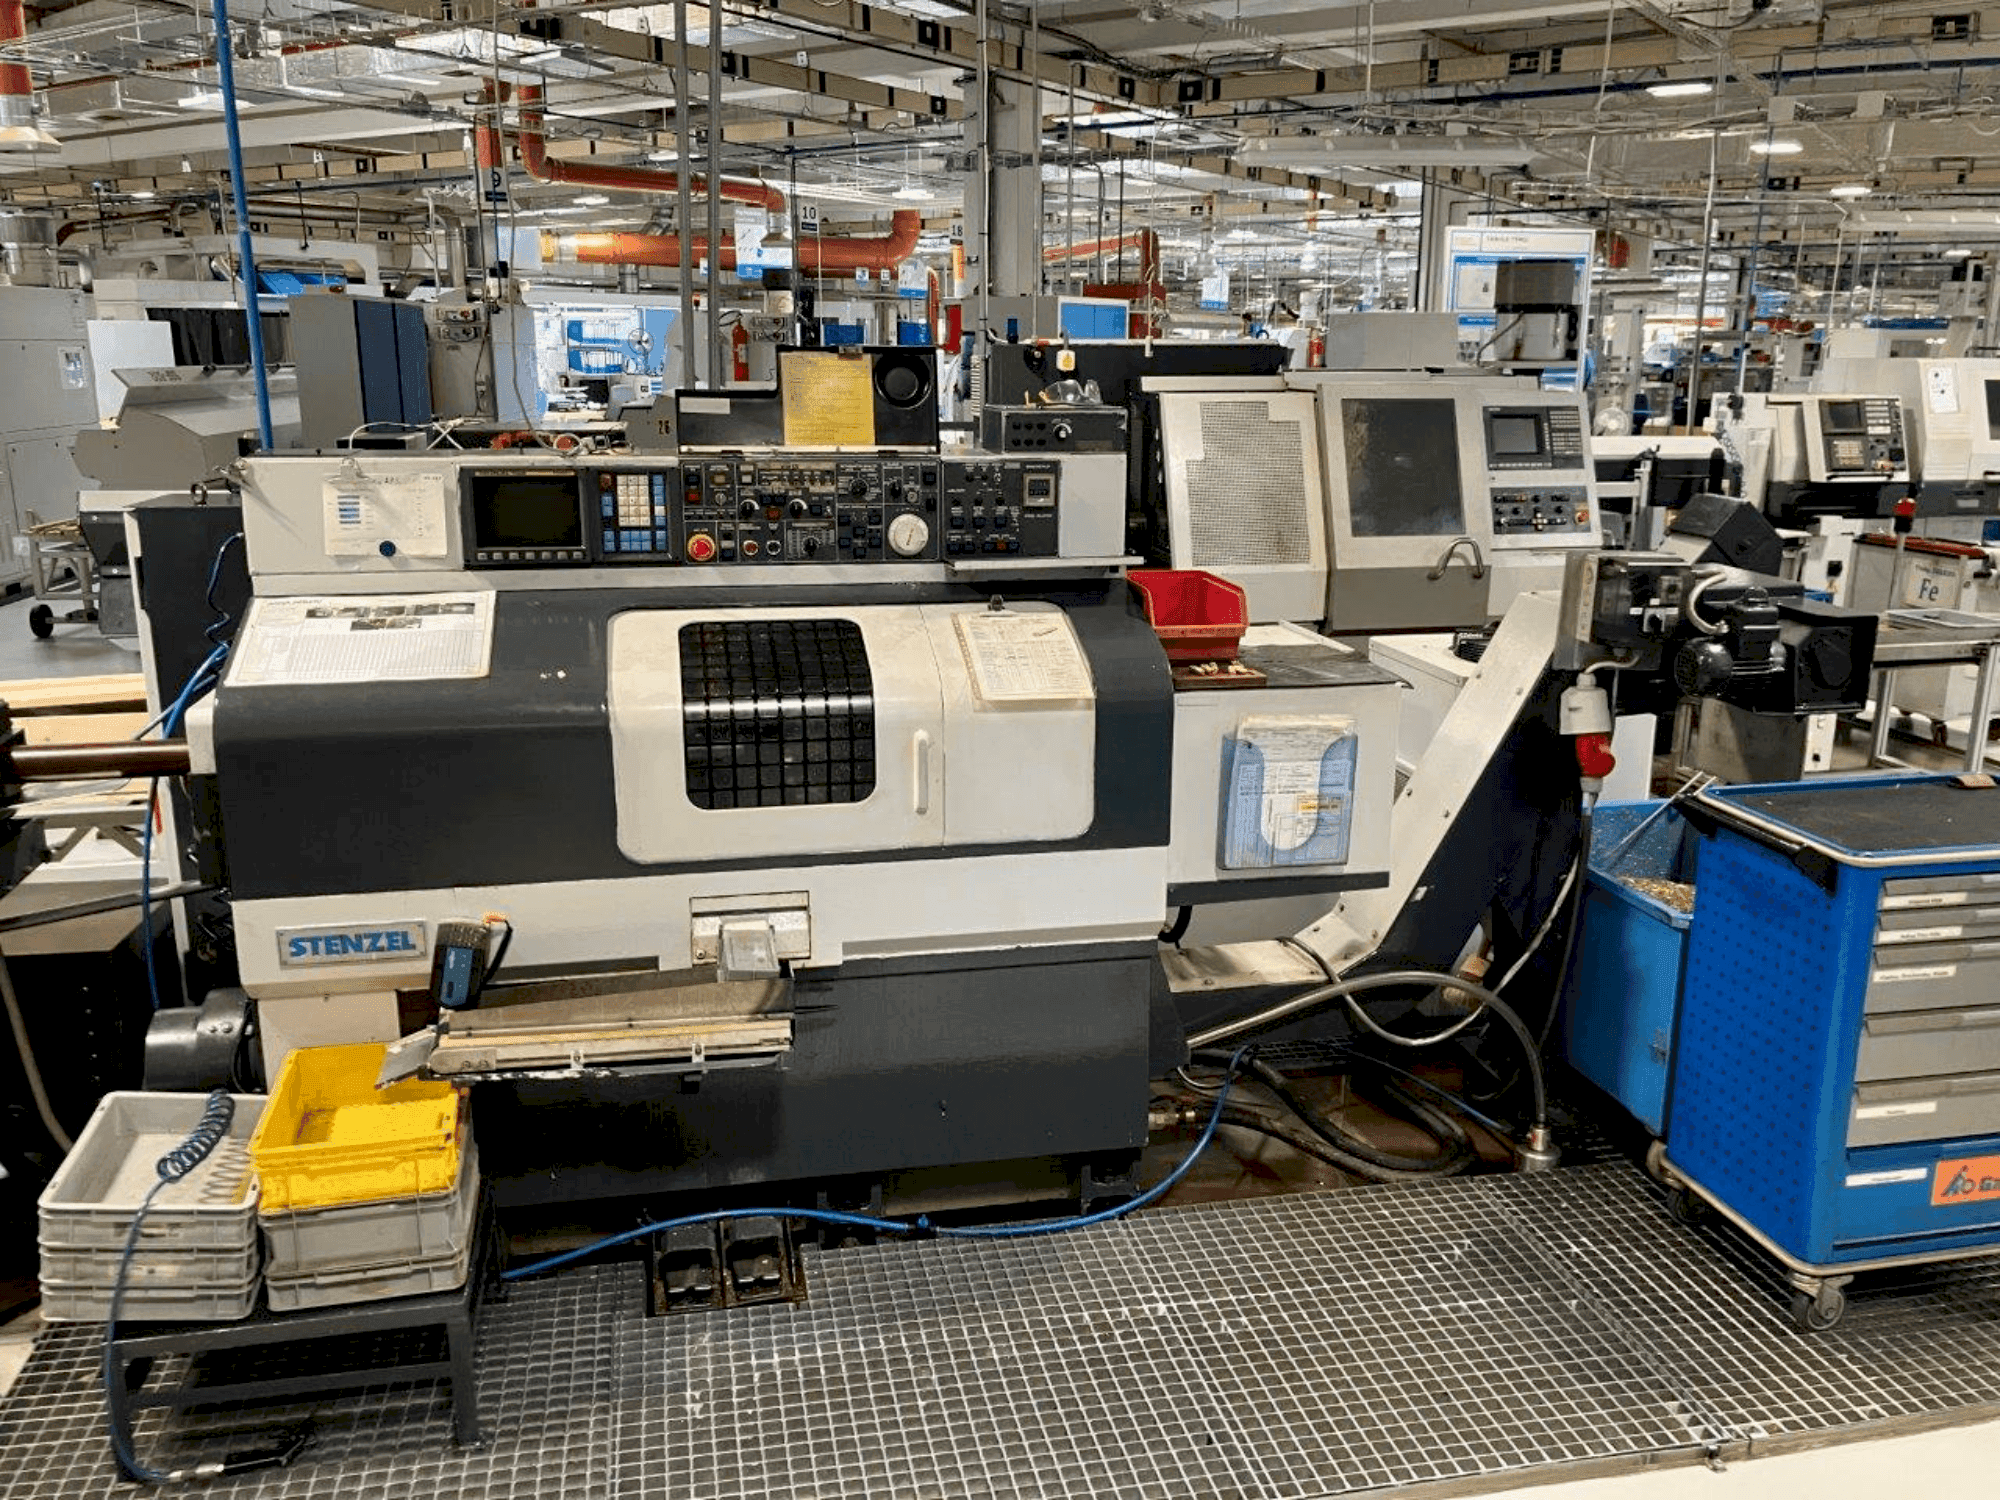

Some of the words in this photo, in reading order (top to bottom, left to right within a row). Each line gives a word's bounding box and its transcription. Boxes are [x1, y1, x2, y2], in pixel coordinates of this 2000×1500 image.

[802, 206, 817, 219] 10
[952, 224, 963, 236] 18
[1918, 578, 1939, 602] Fe
[289, 930, 417, 957] STENZEL
